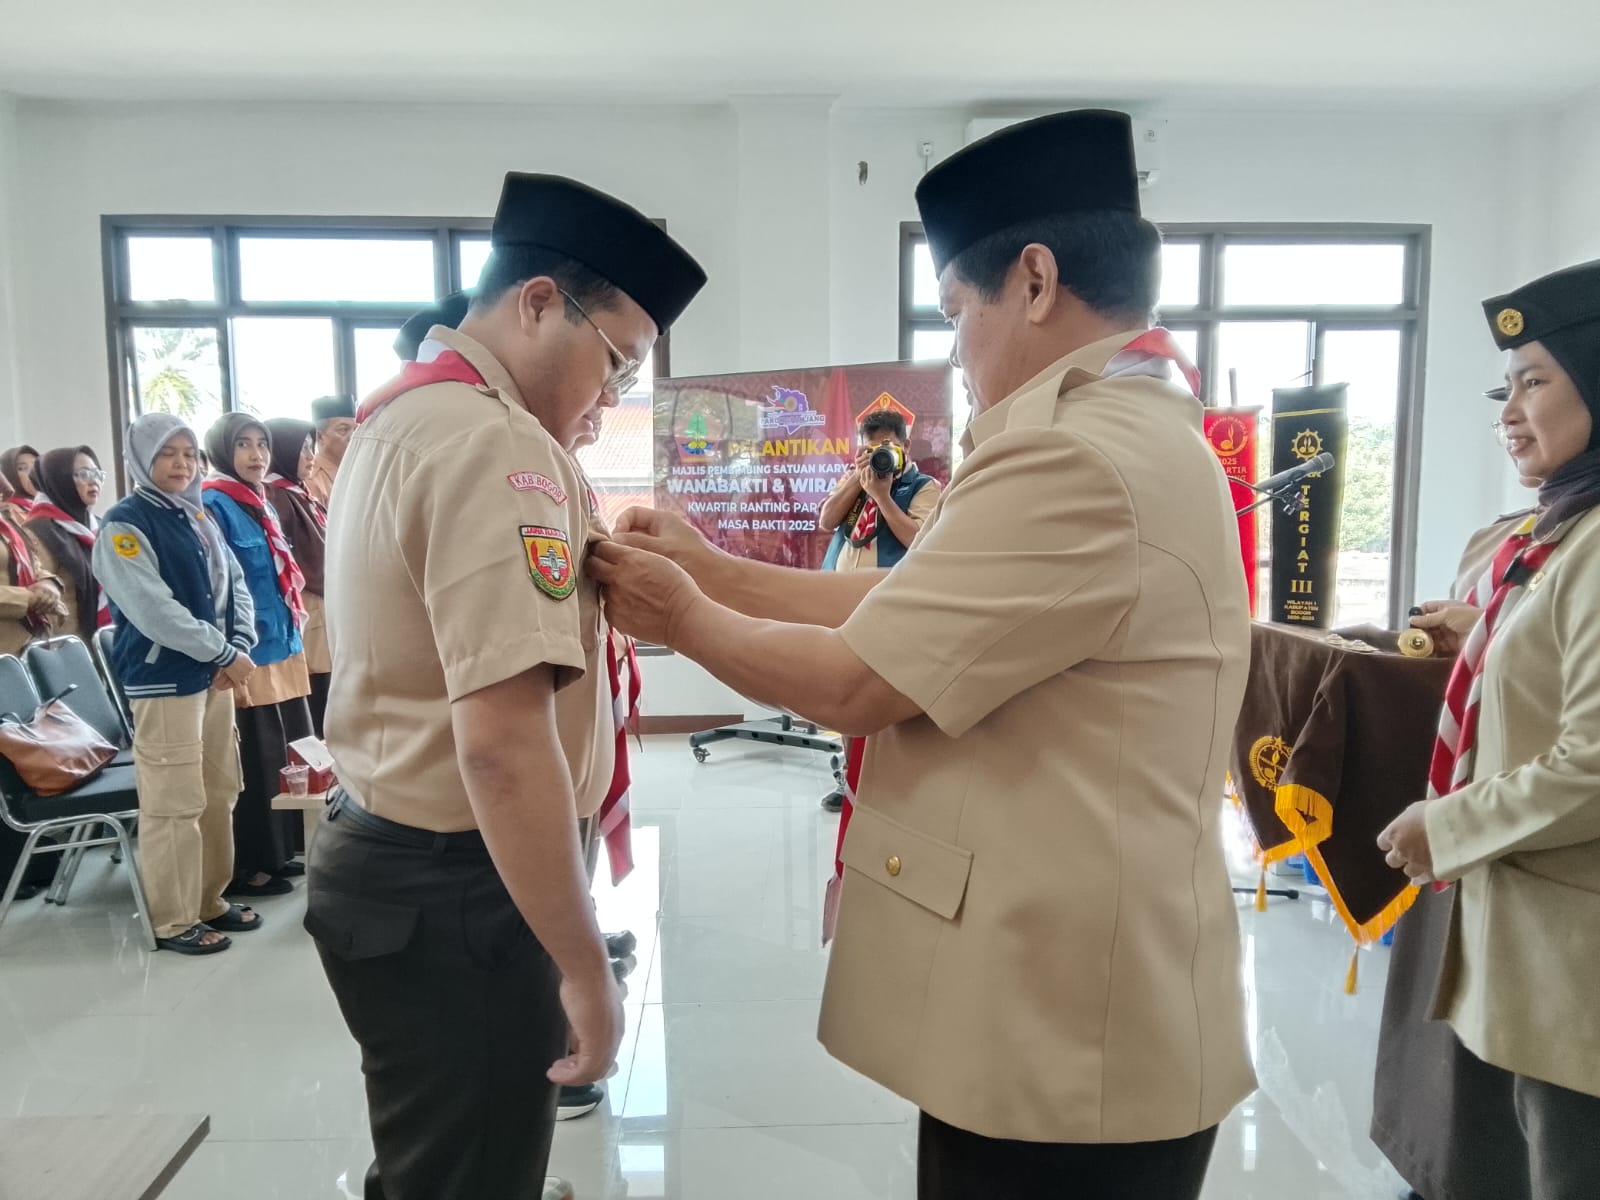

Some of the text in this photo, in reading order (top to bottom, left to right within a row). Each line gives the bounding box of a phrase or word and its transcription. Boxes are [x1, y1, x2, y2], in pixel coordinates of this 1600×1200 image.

[727, 437, 850, 458] PELANTIKAN
[1220, 457, 1237, 465] 025
[672, 465, 706, 476] MAJLIS
[773, 463, 816, 474] SATUAN
[513, 475, 563, 501] KAB BOGOR
[667, 477, 837, 494] WANABAKTI & WIRA
[687, 502, 818, 514] KWARTIR RANTING PAR
[718, 519, 816, 531] MASA BAKTI 2025
[1297, 484, 1311, 573] TERGIAT
[1290, 579, 1312, 593] III
